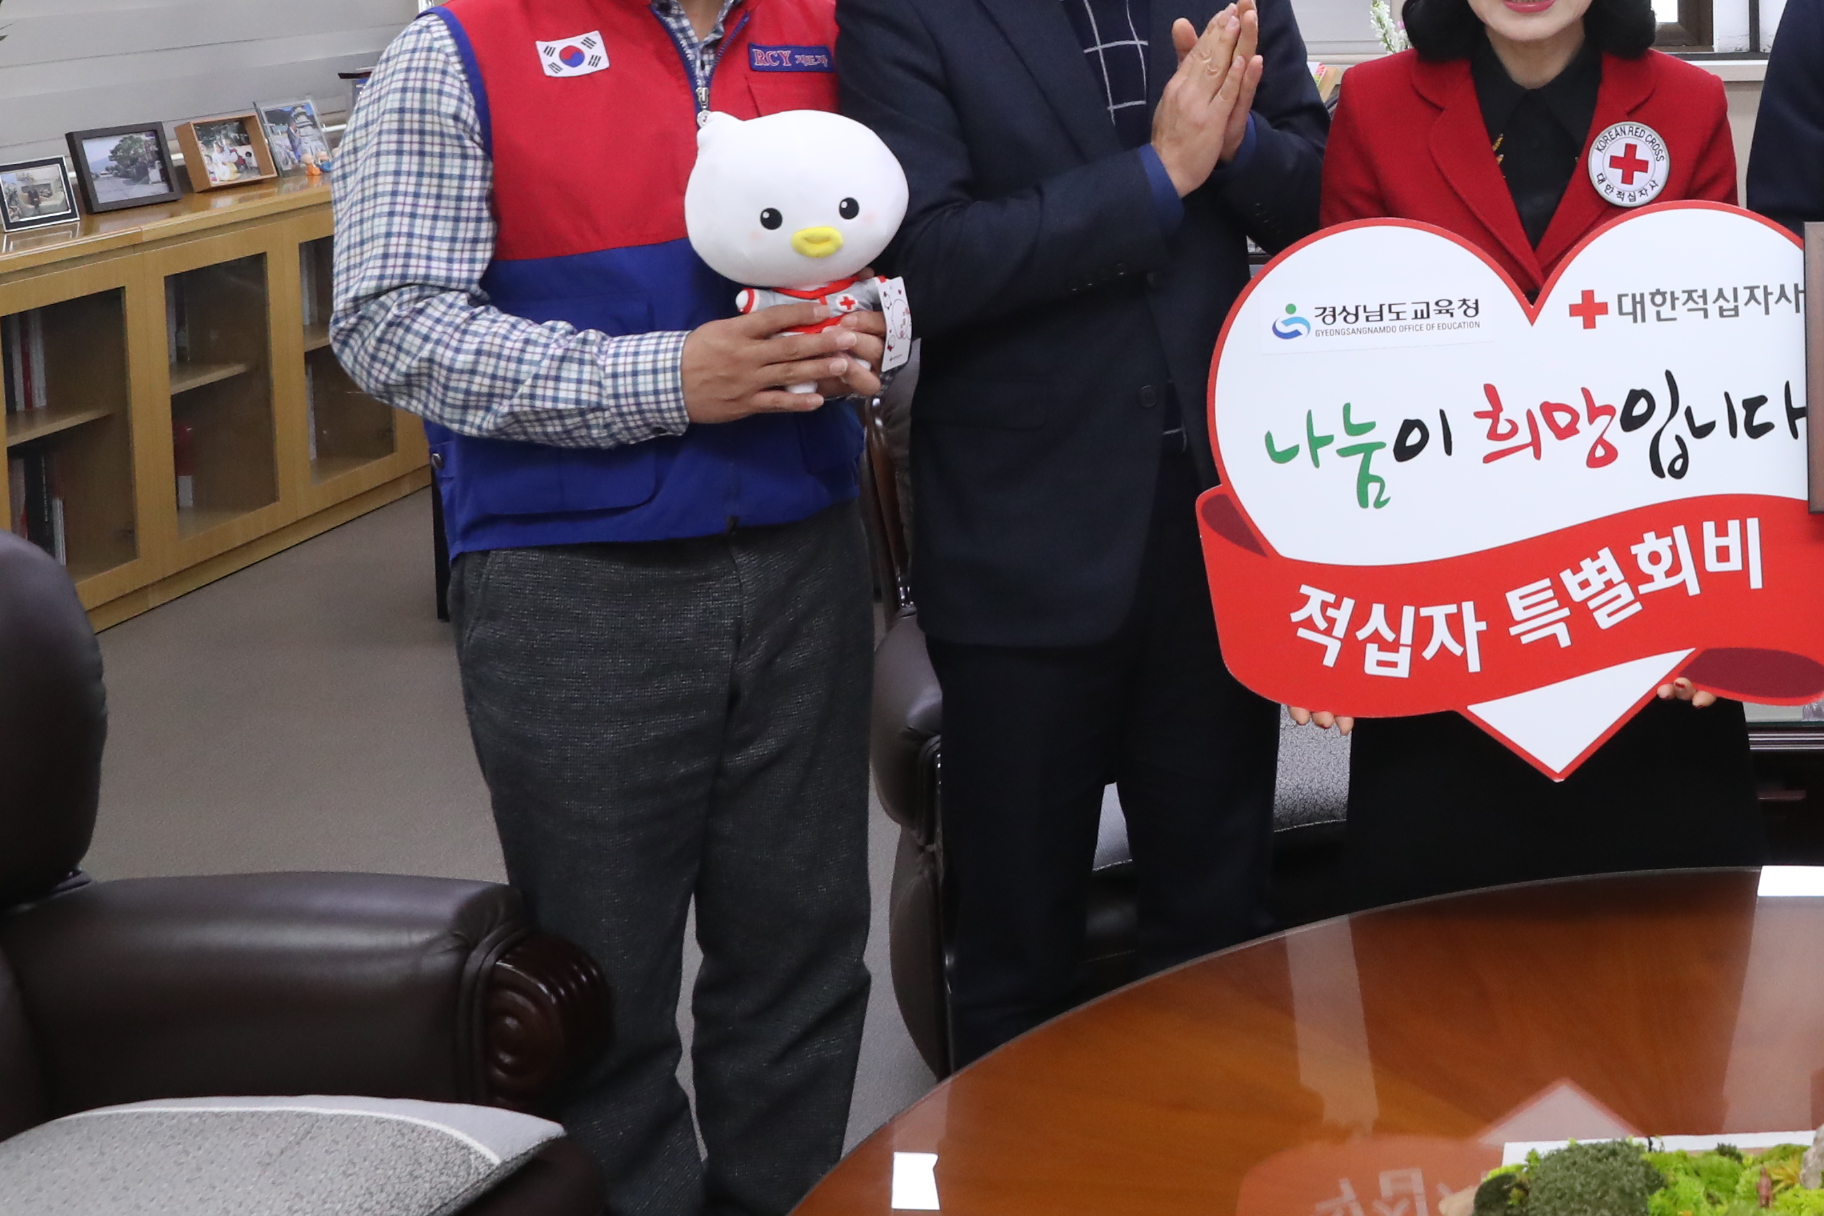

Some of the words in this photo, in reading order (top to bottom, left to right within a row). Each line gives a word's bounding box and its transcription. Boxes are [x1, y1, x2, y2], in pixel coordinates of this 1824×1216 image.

[752, 48, 792, 67] RCY
[1595, 126, 1627, 154] KOREAN
[1627, 125, 1646, 139] RED
[1645, 134, 1665, 162] CROSS
[1596, 173, 1659, 202] 대한적십자사
[1314, 298, 1480, 326] 경상남도교육청
[1617, 281, 1805, 325] 대한적십자사
[1315, 325, 1397, 338] GYEONGSANGNAMDO
[1398, 323, 1424, 333] OFFICE
[1426, 323, 1436, 332] OF
[1437, 320, 1481, 331] EDUCATION
[1264, 400, 1453, 510] 나눔이
[1473, 368, 1806, 480] 희망입니다
[1289, 582, 1487, 679] 적십자
[1504, 516, 1764, 650] 특별회비
